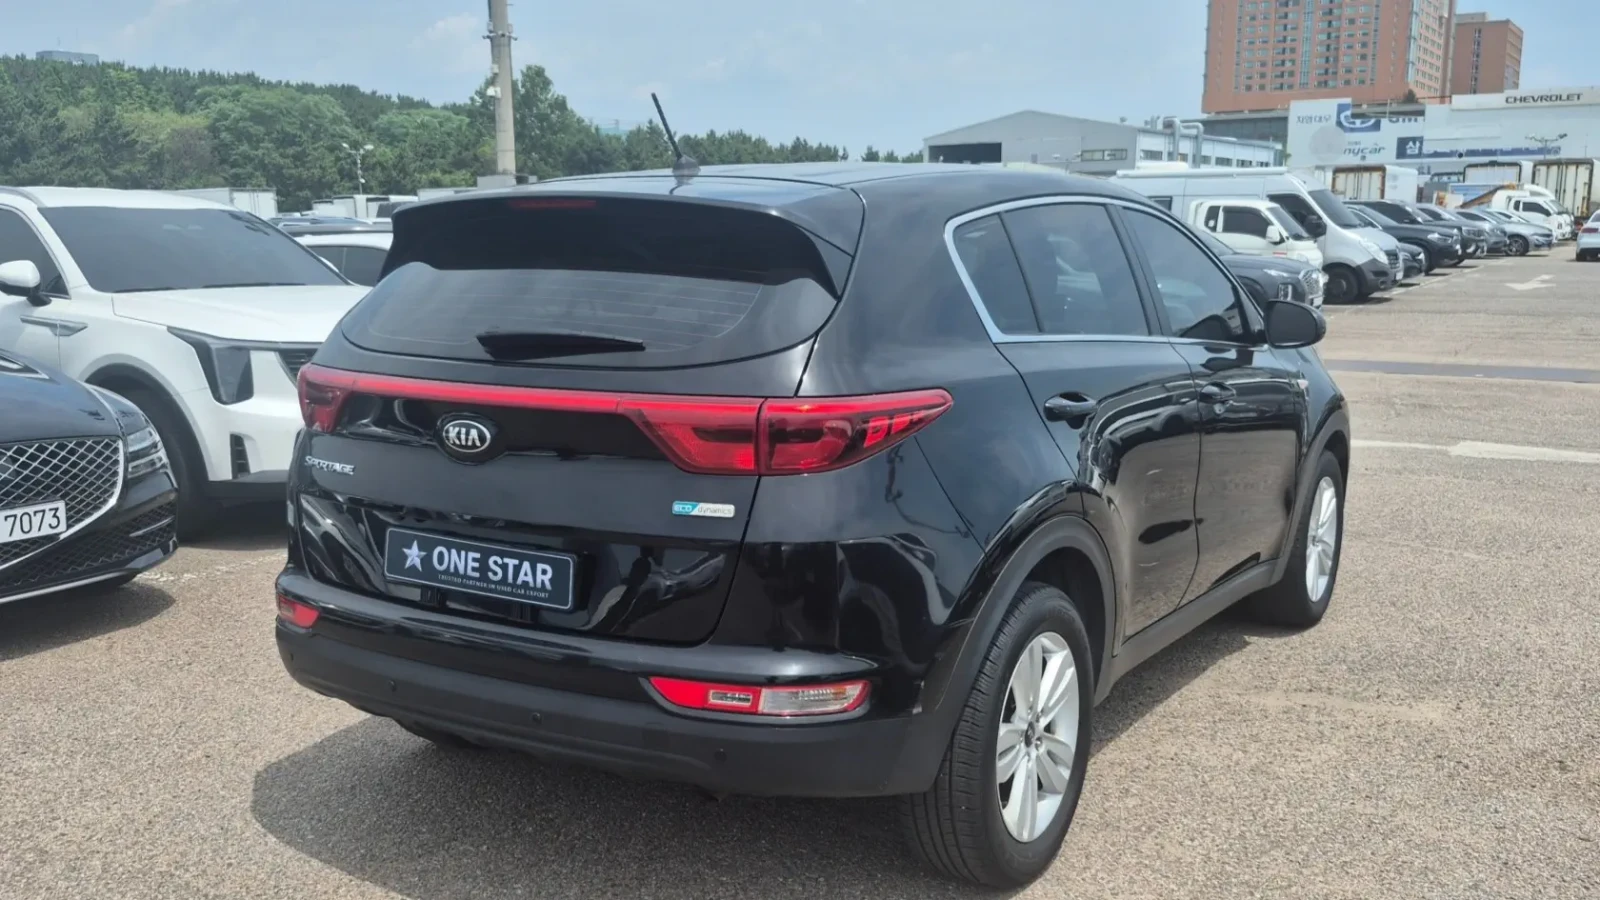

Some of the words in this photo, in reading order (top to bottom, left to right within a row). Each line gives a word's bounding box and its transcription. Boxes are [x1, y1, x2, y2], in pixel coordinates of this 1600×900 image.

[1505, 93, 1583, 104] CHEVROLET
[449, 426, 481, 447] KIA
[305, 456, 355, 475] SPORTAGE
[673, 504, 693, 512] ECO
[698, 506, 732, 515] dynamics
[4, 507, 61, 537] 7073
[432, 545, 481, 578] ONE
[487, 555, 553, 591] STAR
[438, 574, 462, 584] TRUSTED
[463, 579, 487, 588] PARTNER
[496, 585, 512, 593] USED
[526, 590, 549, 598] EXPORT
